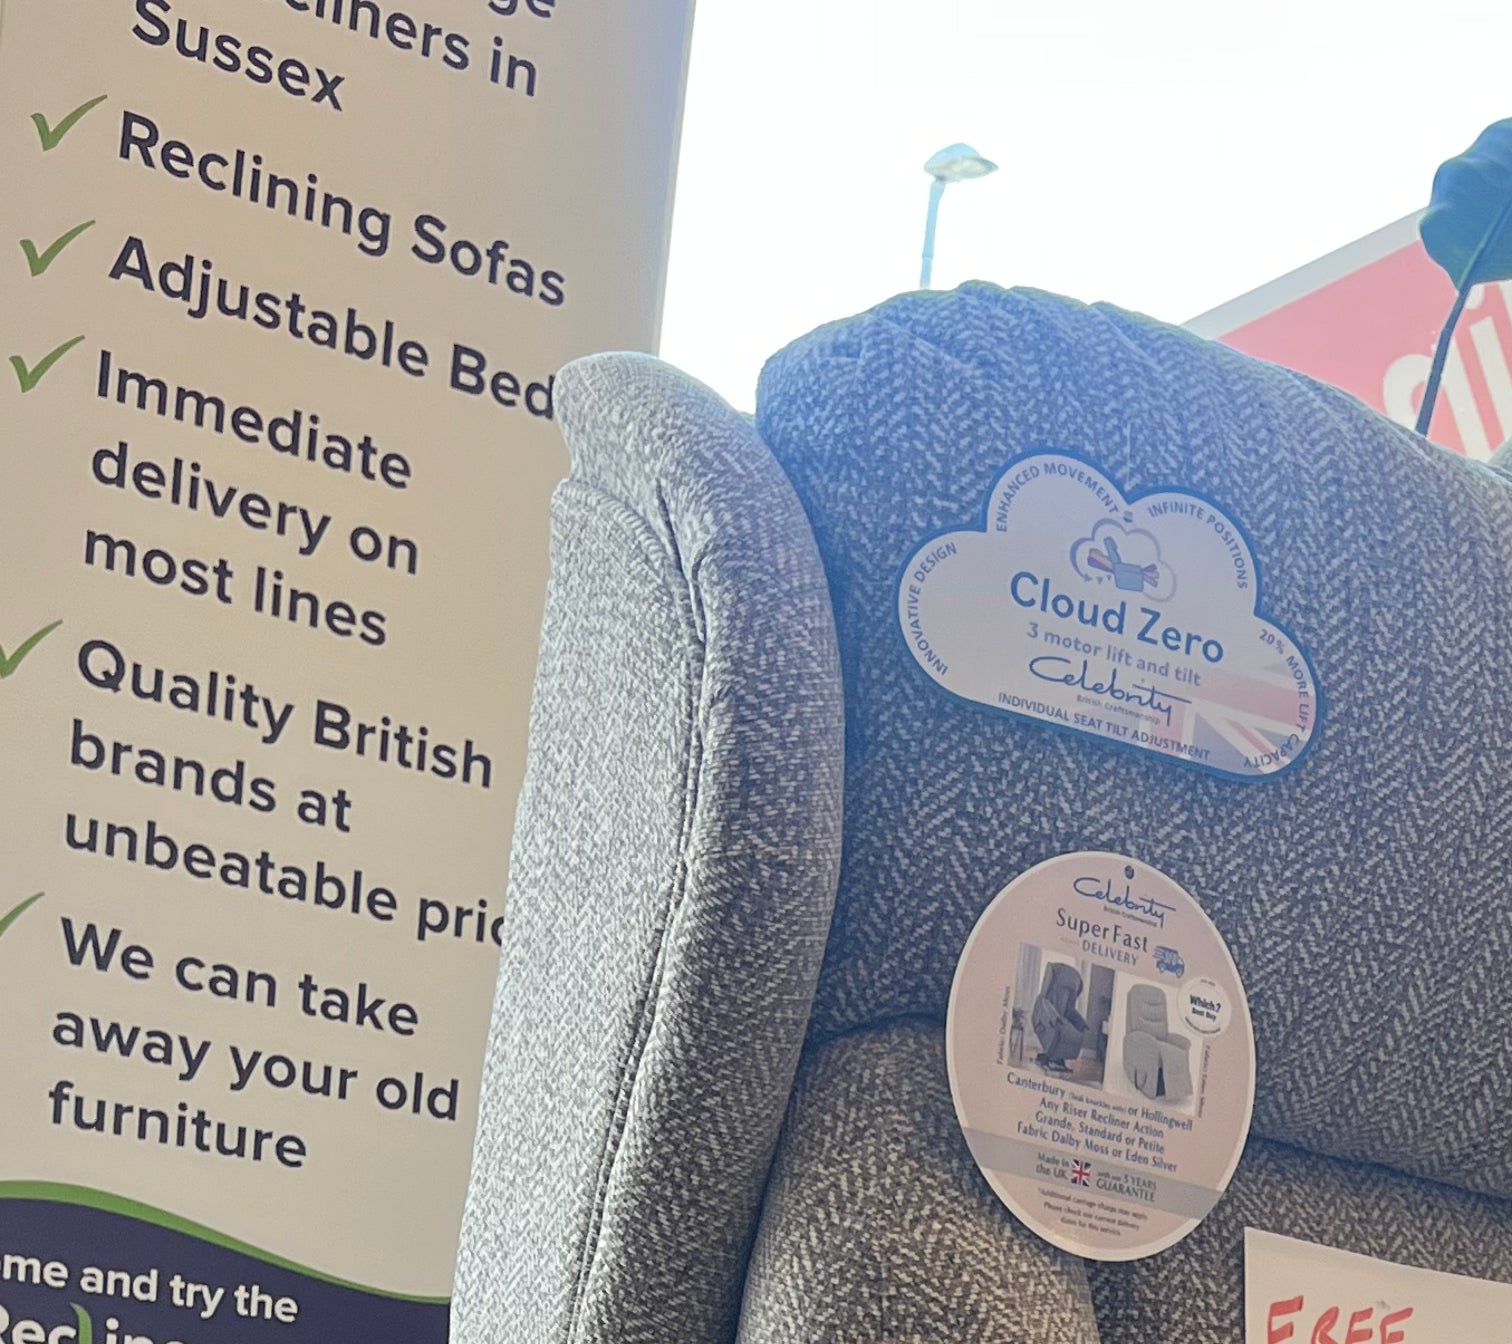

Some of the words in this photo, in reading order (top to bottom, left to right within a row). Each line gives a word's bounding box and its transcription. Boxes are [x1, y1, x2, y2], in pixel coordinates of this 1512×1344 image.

[132, 0, 344, 111] Sussex
[490, 37, 537, 96] in
[119, 111, 391, 256] Reclining
[411, 215, 564, 305] Sofas
[109, 236, 428, 377] Adjustable
[97, 350, 410, 488] Immediate
[92, 442, 331, 555] delivery
[349, 523, 418, 574] on
[997, 466, 1040, 533] ENHANCED
[1044, 462, 1120, 516] MOVEMENT
[914, 542, 957, 583] DESIGN
[1147, 501, 1205, 520] INFINITE
[1206, 514, 1248, 589] POSITIONS
[85, 529, 232, 604] most
[254, 568, 387, 646] lines
[1010, 571, 1126, 635] Cloud
[1137, 606, 1224, 663] Zero
[908, 584, 948, 676] INNOVATIVE
[1027, 622, 1039, 638] 3
[1044, 630, 1103, 656] motor
[1106, 645, 1132, 666] lift
[1137, 657, 1168, 677] and
[1174, 668, 1201, 686] tilt
[1259, 629, 1286, 655] 20%
[1029, 656, 1192, 727] Celebrity
[1286, 655, 1309, 698] MORE
[78, 640, 295, 744] Quality
[313, 700, 493, 788] British
[998, 692, 1069, 721] INDIVIDUAL
[1074, 713, 1100, 730] SEAT
[1107, 722, 1128, 737] TILT
[1132, 730, 1210, 760] ADJUSTMENT
[1297, 703, 1309, 732] LIFT
[71, 719, 277, 812] brands
[297, 789, 351, 832] at
[1244, 733, 1299, 768] CAPACITY
[66, 813, 397, 921] unbeatable
[1073, 877, 1176, 928] Celebrity
[61, 917, 153, 980] We
[176, 956, 276, 1007] can
[299, 974, 419, 1037] take
[1082, 939, 1138, 966] DELIVERY
[1190, 993, 1221, 1013] Which?
[52, 1010, 211, 1081] away
[230, 1043, 358, 1100] your
[376, 1072, 459, 1122] old
[48, 1081, 307, 1168] furniture
[1007, 1072, 1065, 1100] Canterbury
[1127, 1107, 1138, 1116] or
[1141, 1109, 1193, 1131] Hollingwell
[1040, 1097, 1059, 1113] Any
[1062, 1103, 1087, 1119] Riser
[1091, 1109, 1130, 1130] Recliner
[1133, 1123, 1164, 1139] Action
[1017, 1121, 1048, 1140] Fabric
[1052, 1131, 1080, 1149] Dalby
[1084, 1138, 1109, 1156] Moss
[1112, 1148, 1122, 1158] or
[1125, 1149, 1149, 1165] Eden
[1152, 1155, 1177, 1173] Silver
[1038, 1152, 1059, 1166] Made
[1079, 1120, 1122, 1143] Standard
[1125, 1136, 1136, 1145] or
[1139, 1138, 1165, 1154] Petite
[1036, 1163, 1051, 1175] the
[1053, 1168, 1068, 1180] UK
[1096, 1178, 1156, 1202] GUARANTEE
[80, 1266, 158, 1302] and
[169, 1275, 223, 1318] try
[234, 1286, 298, 1322] the
